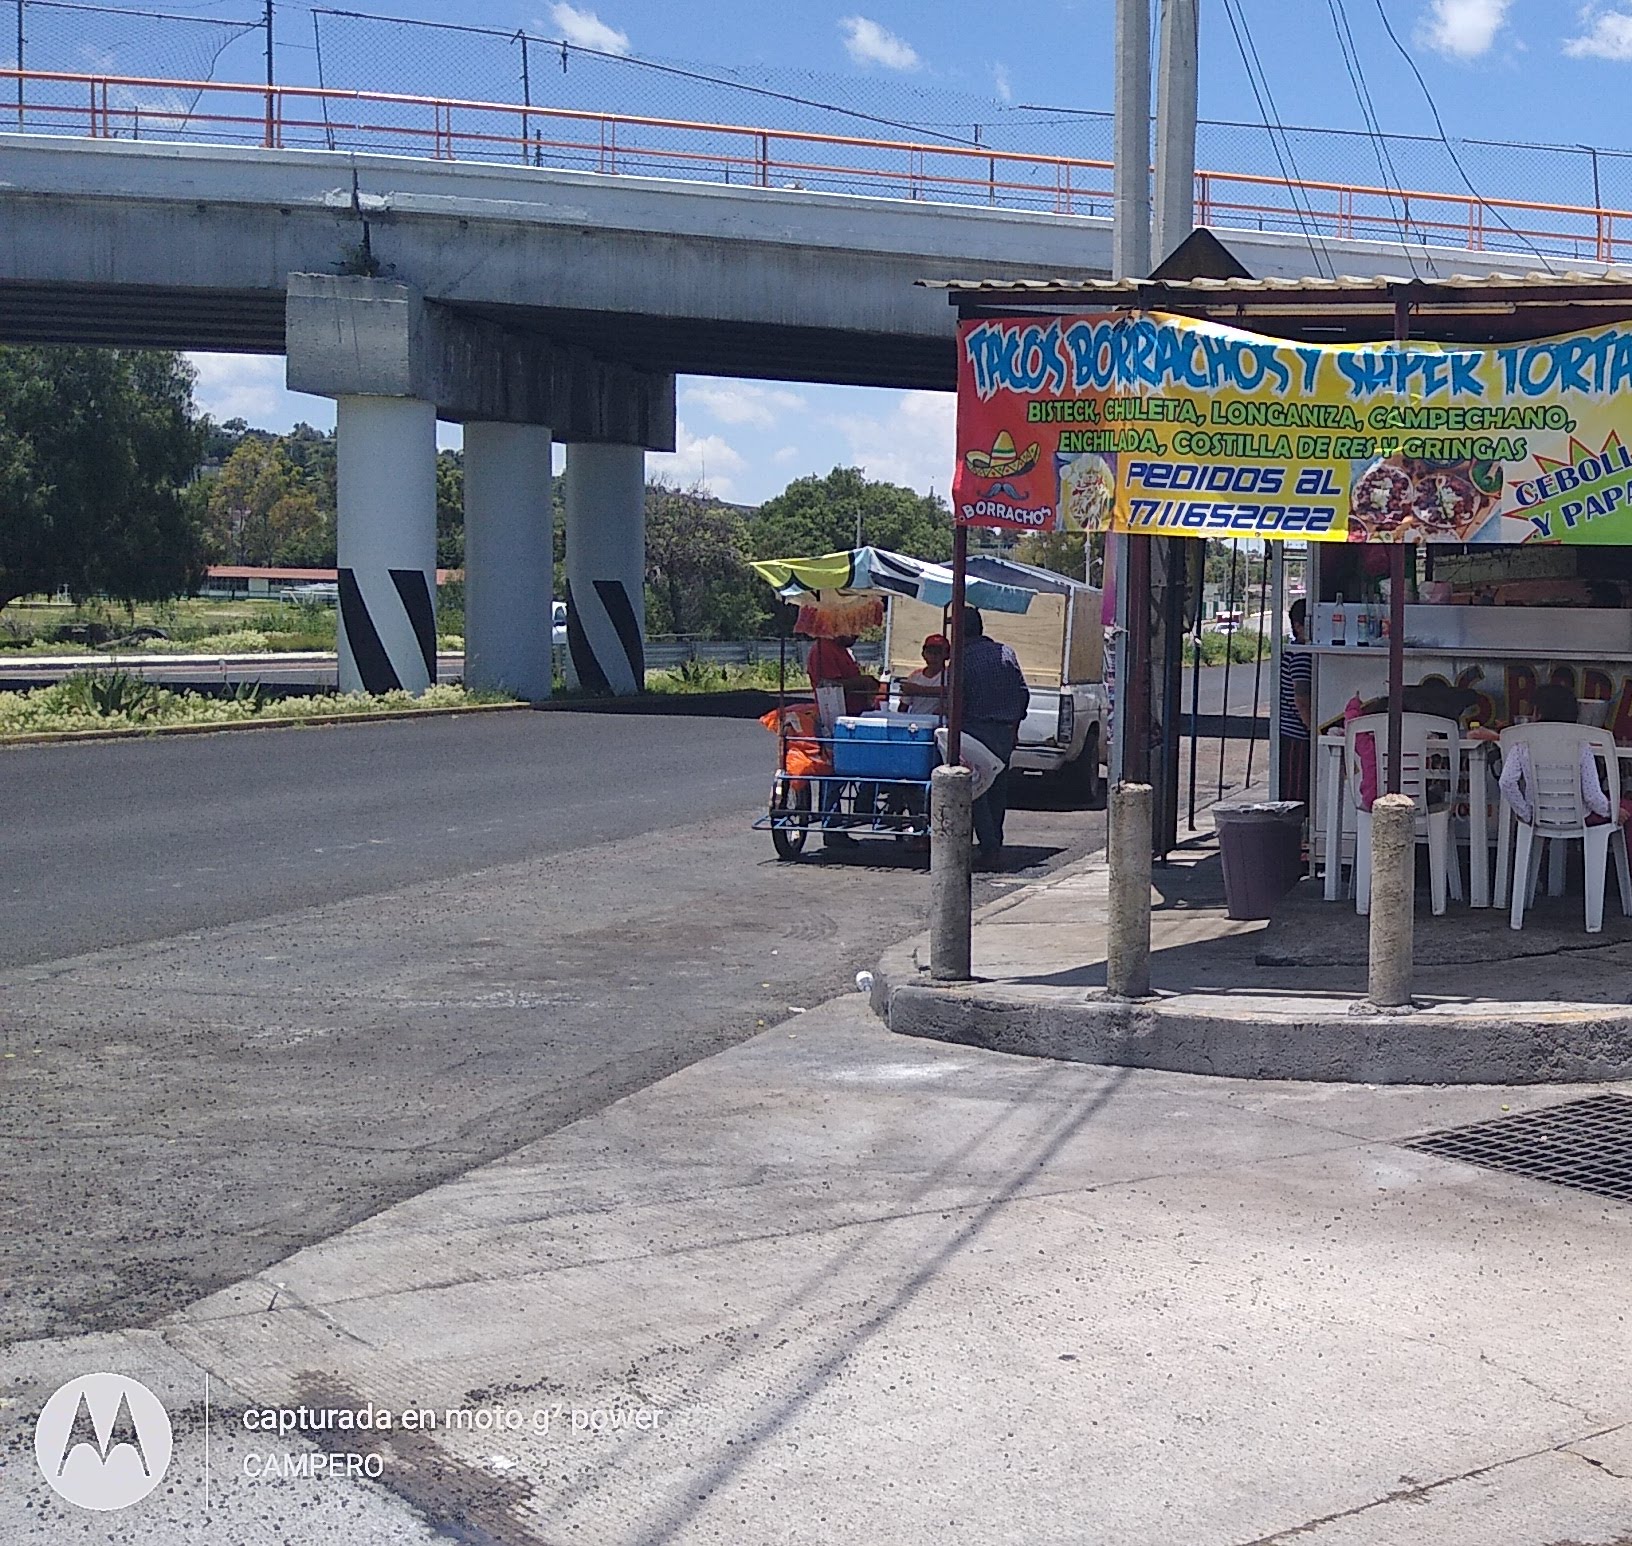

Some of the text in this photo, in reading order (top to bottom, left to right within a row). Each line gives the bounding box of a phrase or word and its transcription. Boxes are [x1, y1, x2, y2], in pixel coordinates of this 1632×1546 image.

[966, 321, 1066, 398] TACOS
[1068, 319, 1289, 394] BORRACHOS
[1297, 346, 1323, 393] Y
[1338, 350, 1485, 398] SUPER
[1027, 399, 1577, 433] BISTECK, CHULETA, LONGANIZA, CAMPECHANO,
[1057, 428, 1528, 462] ENCHILADA, COSTILLA DE RES Y GRINGAS
[961, 501, 1052, 525] BORRACHOS
[1530, 512, 1551, 537] Y
